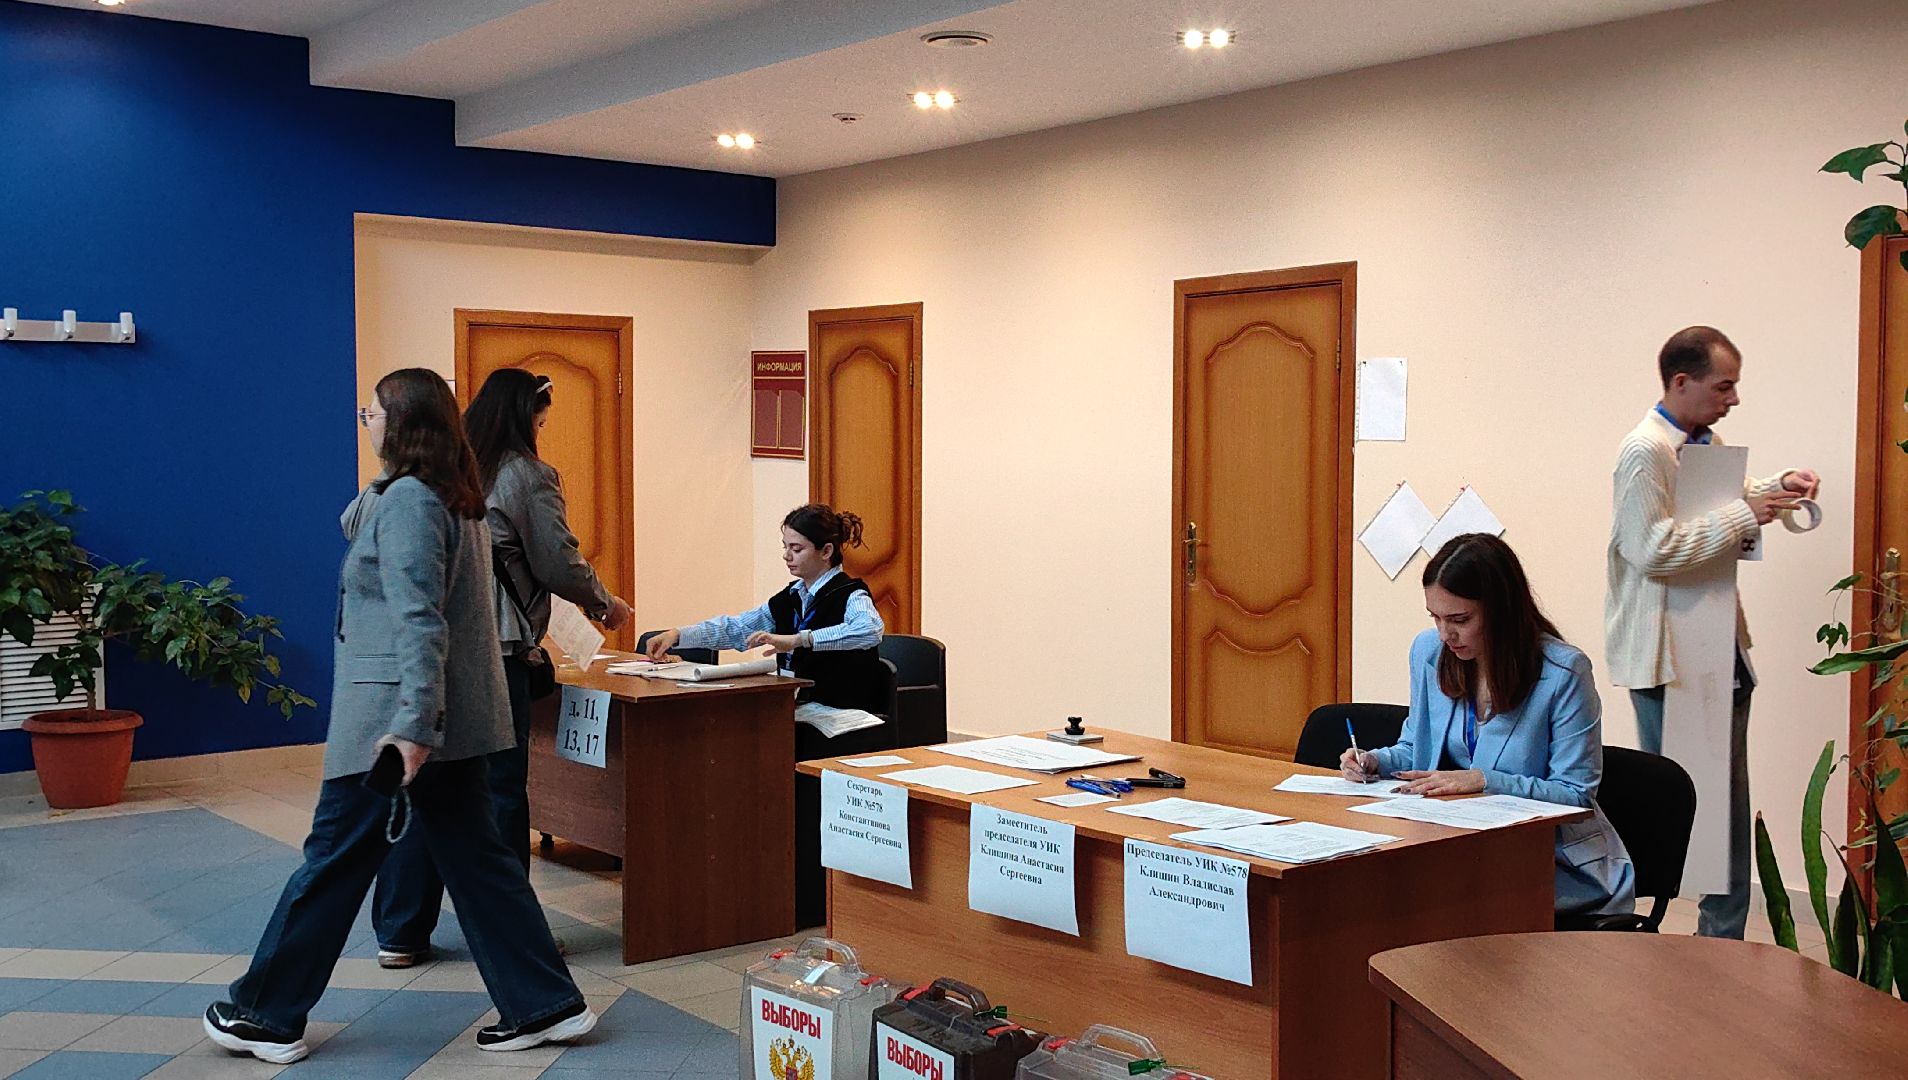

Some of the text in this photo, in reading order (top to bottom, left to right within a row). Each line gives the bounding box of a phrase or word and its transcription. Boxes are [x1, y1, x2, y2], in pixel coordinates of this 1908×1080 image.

[757, 361, 802, 373] ИНФОРМАЦИЯ
[584, 698, 599, 725] 11,
[563, 729, 599, 757] 13, 17
[846, 779, 883, 797] Секретарь
[846, 795, 884, 813] УИК №578
[839, 810, 891, 831] Константинова
[996, 813, 1048, 835] Заместитель
[828, 822, 902, 849] Анастасия Сергеевна
[984, 829, 1061, 855] председателя УИК
[980, 843, 1019, 863] Клишина
[1127, 843, 1249, 880] Председатель УИК №578
[999, 865, 1043, 885] Сергеевна
[1139, 864, 1235, 896] Клишин Владислав
[1148, 885, 1225, 912] Александрович
[761, 998, 822, 1040] ВЫБОРЫ
[886, 1036, 944, 1080] ВЫБОРЫ
